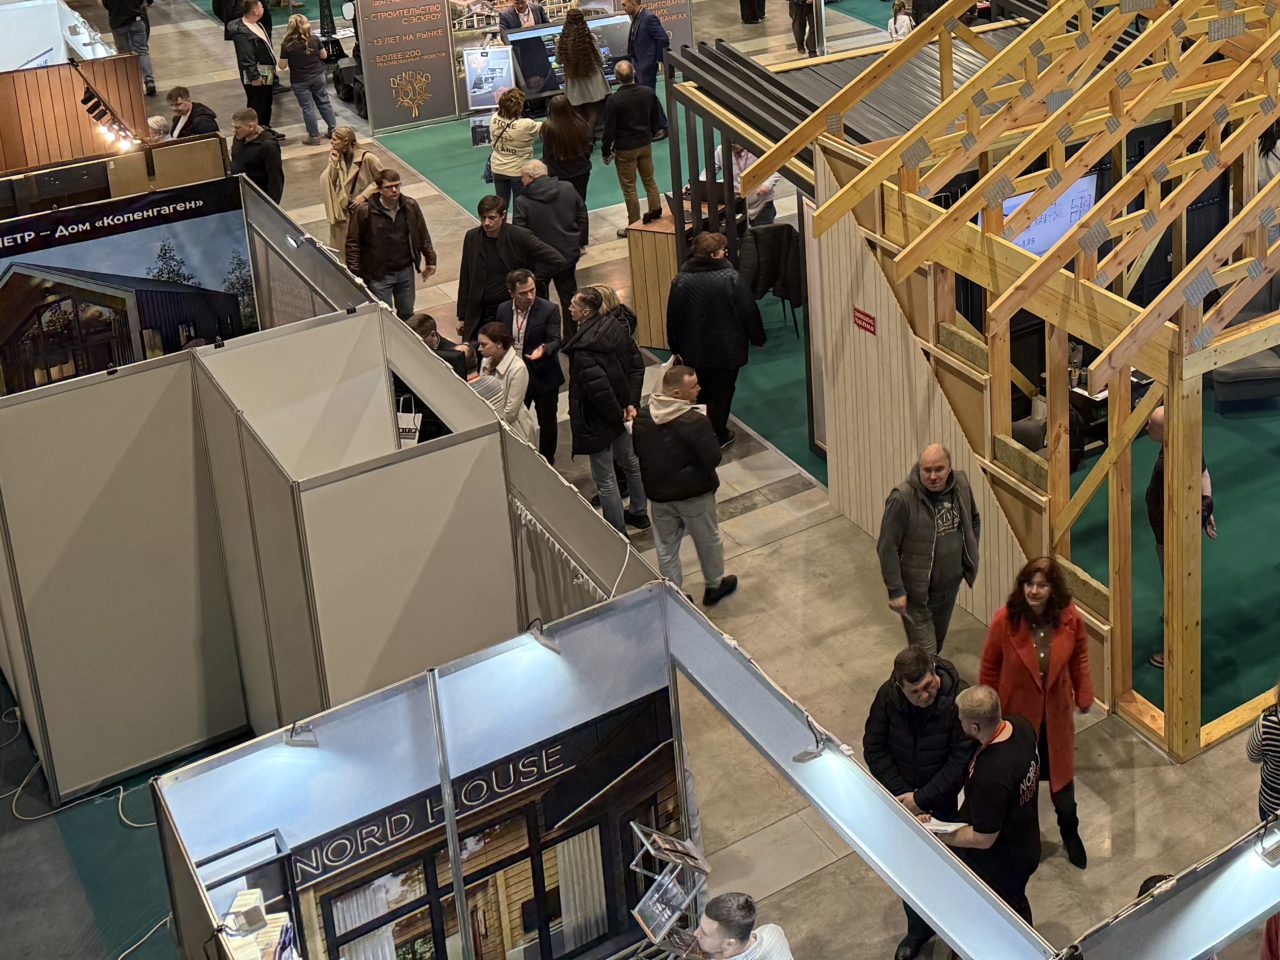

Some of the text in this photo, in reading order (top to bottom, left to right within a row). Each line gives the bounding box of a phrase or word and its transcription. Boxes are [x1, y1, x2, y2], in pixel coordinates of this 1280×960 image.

[370, 4, 441, 20] СТРОИТЕЛЬСТВО
[402, 12, 442, 25] С ЭСКРОУ
[384, 35, 401, 44] ЛЕТ
[402, 34, 414, 42] НА
[416, 28, 444, 39] РЫНКЕ
[376, 49, 421, 63] БОЛЕЕ 200
[390, 70, 431, 88] DENDRO
[54, 221, 91, 239] Дом
[95, 199, 204, 228] «Копенгаген»
[291, 745, 565, 884] NORD HOUSE
